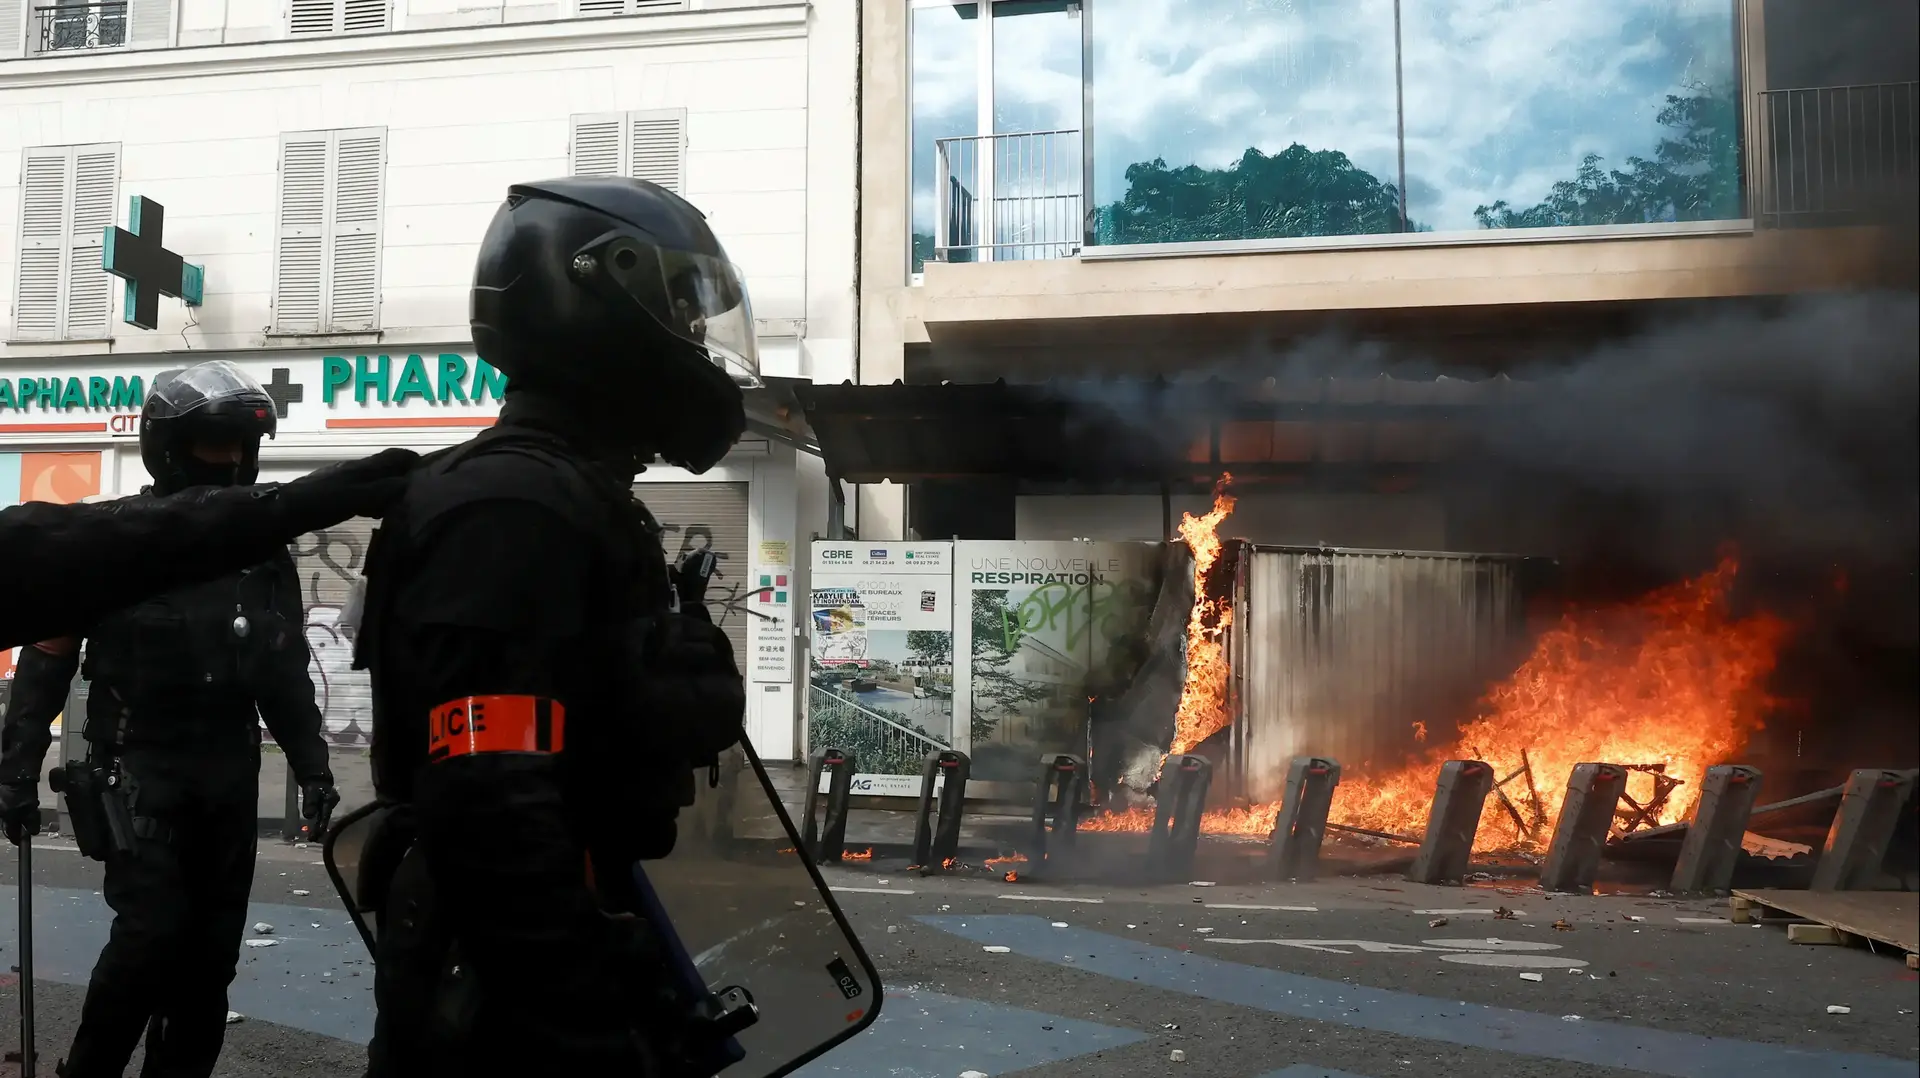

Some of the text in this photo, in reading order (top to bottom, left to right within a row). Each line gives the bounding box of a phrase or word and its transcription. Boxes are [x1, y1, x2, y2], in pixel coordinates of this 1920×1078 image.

[0, 375, 156, 409] APHARM
[110, 414, 142, 432] CIT
[822, 550, 853, 559] CBRE
[971, 557, 1121, 572] UNE NOUVELLE
[971, 572, 1104, 586] RESPIRATION
[431, 704, 487, 744] LICE
